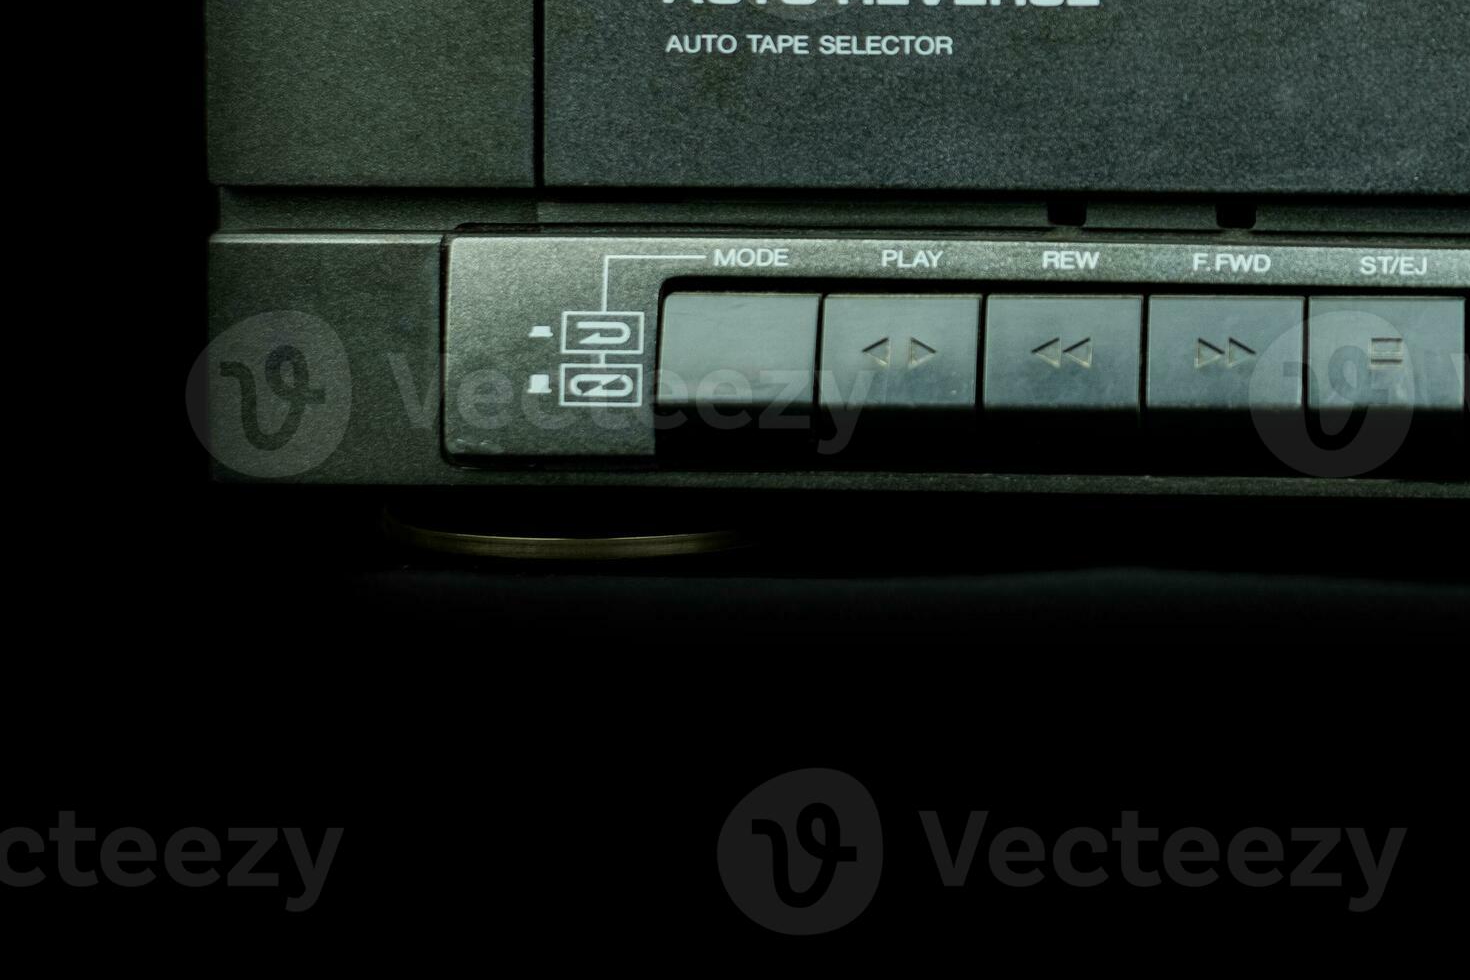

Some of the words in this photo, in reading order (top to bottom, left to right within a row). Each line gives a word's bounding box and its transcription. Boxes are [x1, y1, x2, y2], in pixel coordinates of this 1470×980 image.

[665, 34, 737, 54] AUTO
[747, 34, 810, 54] TAPE
[819, 35, 953, 55] SELECTOR
[713, 247, 789, 267] MODE
[881, 249, 943, 269] PLAY
[1042, 250, 1099, 270] REW
[1193, 253, 1271, 273] F.FWD
[1359, 256, 1428, 276] ST/EJ
